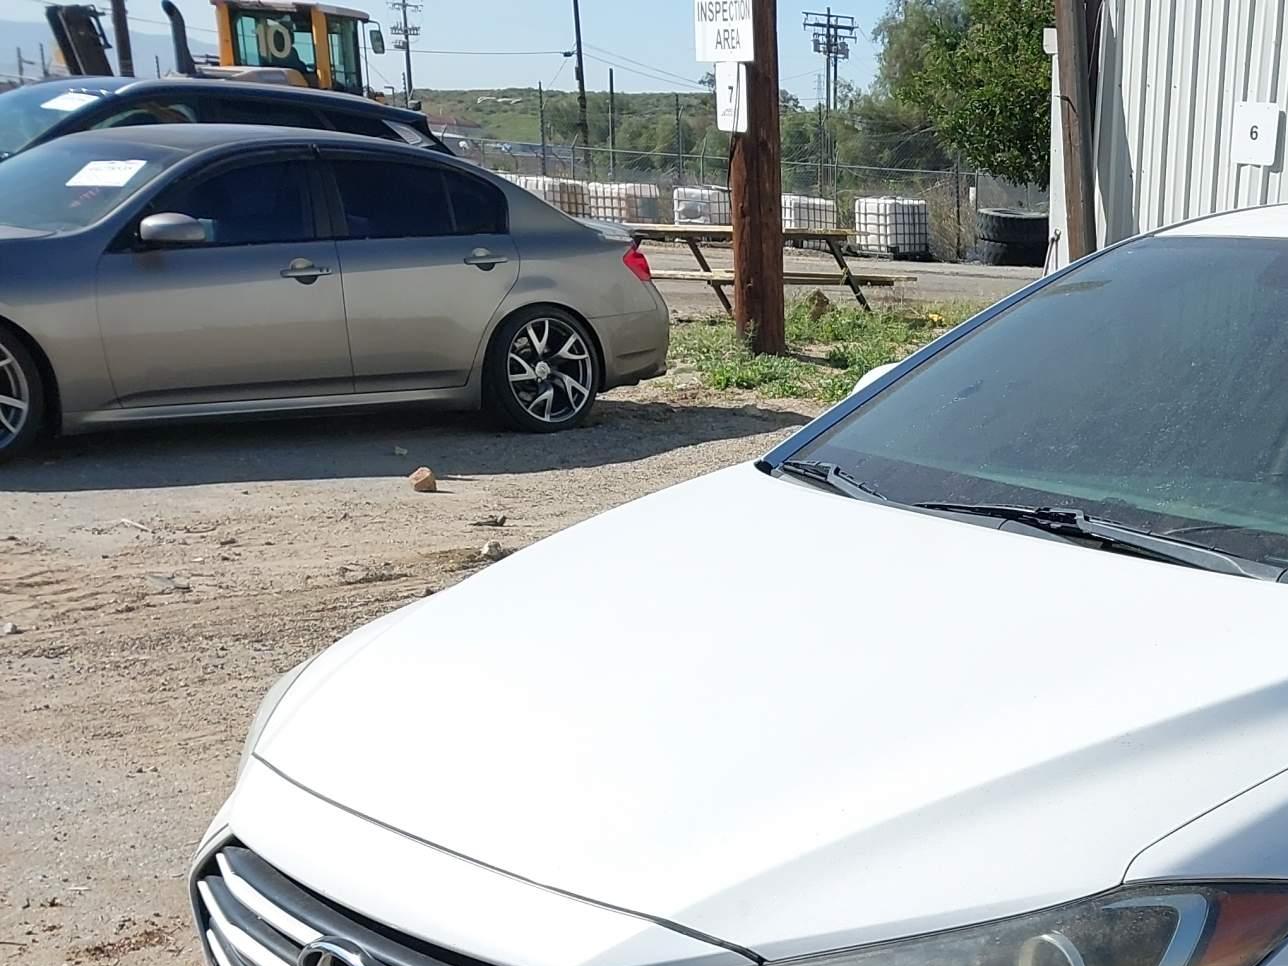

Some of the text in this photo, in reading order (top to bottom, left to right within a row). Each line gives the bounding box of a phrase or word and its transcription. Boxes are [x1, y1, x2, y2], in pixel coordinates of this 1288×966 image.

[697, 0, 750, 21] INSPECTION
[256, 21, 291, 58] 10
[715, 27, 741, 49] AREA
[728, 85, 734, 103] 7
[1249, 125, 1259, 141] 6
